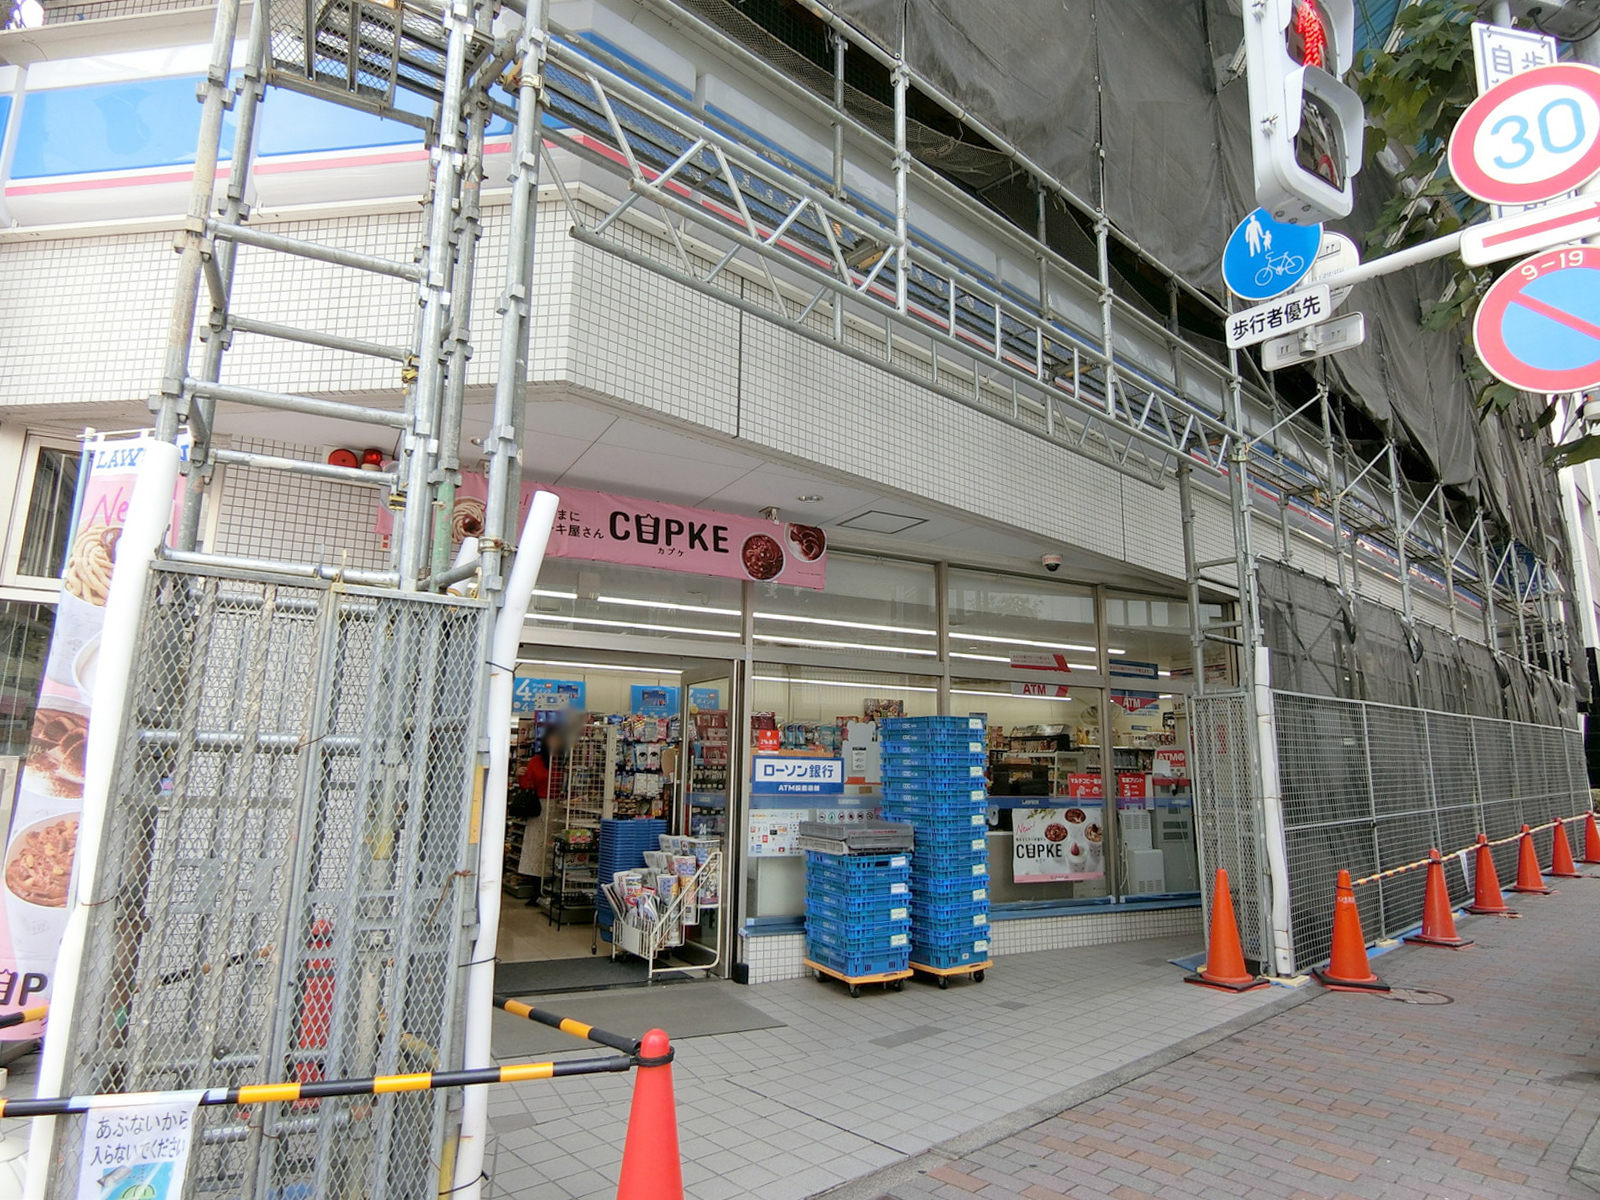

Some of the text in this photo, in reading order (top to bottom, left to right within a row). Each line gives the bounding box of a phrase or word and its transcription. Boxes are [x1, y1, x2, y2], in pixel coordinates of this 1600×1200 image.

[1489, 97, 1585, 170] 30
[1520, 250, 1584, 281] 9-19
[1232, 295, 1321, 342] 歩行者優先
[96, 446, 147, 469] LAW
[86, 485, 130, 532] Ne
[551, 523, 604, 540] キ屋さん
[609, 511, 730, 554] CUPKE
[657, 547, 685, 557] カプケ
[1022, 683, 1047, 696] ATM
[1122, 697, 1141, 708] ATM
[763, 764, 834, 779] ローソン銀行
[1016, 843, 1063, 859] CUPKE
[96, 1110, 189, 1139] あぶないから
[90, 1136, 186, 1167] 入らないでください
